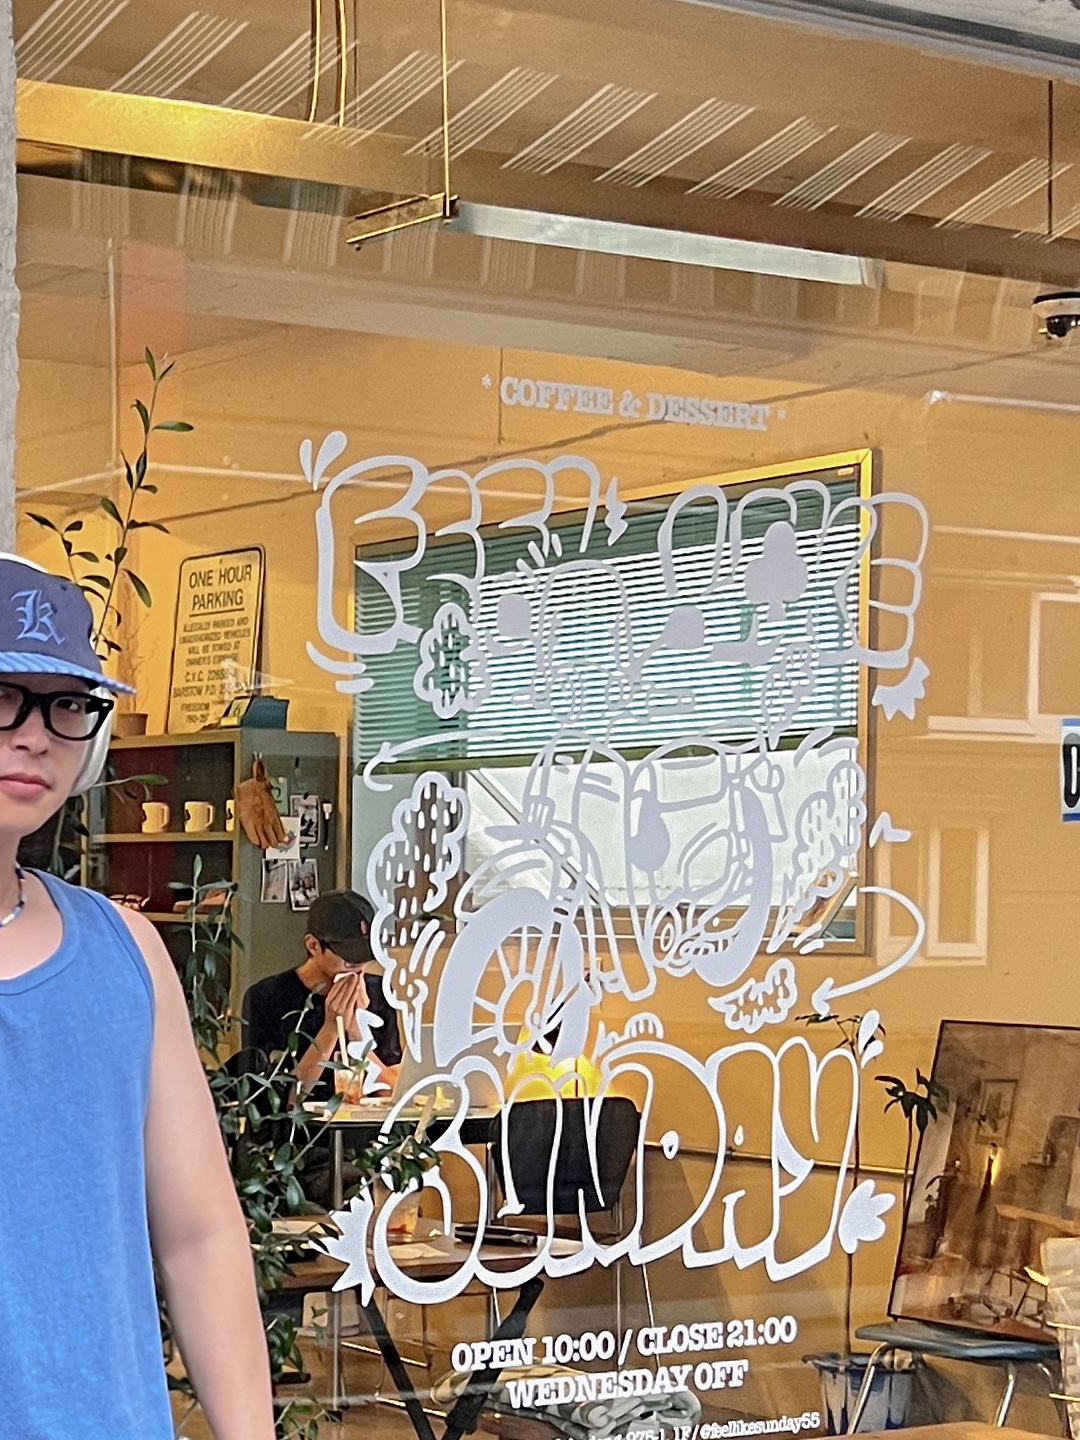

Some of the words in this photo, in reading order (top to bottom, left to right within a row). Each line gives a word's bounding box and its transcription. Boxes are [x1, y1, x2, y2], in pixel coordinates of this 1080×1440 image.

[499, 376, 613, 416] COFFEE
[618, 389, 641, 418] &
[646, 393, 770, 431] DESSERT
[189, 570, 213, 589] ONE
[218, 564, 252, 585] HOUR
[191, 588, 244, 612] PARKING
[451, 1337, 537, 1373] OPEN
[541, 1330, 616, 1364] 10:00
[618, 1329, 633, 1365] /
[637, 1321, 724, 1356] CLOSE
[726, 1315, 797, 1349] 21:00
[505, 1365, 694, 1409] WEDNESDAY
[694, 1359, 749, 1392] OFF
